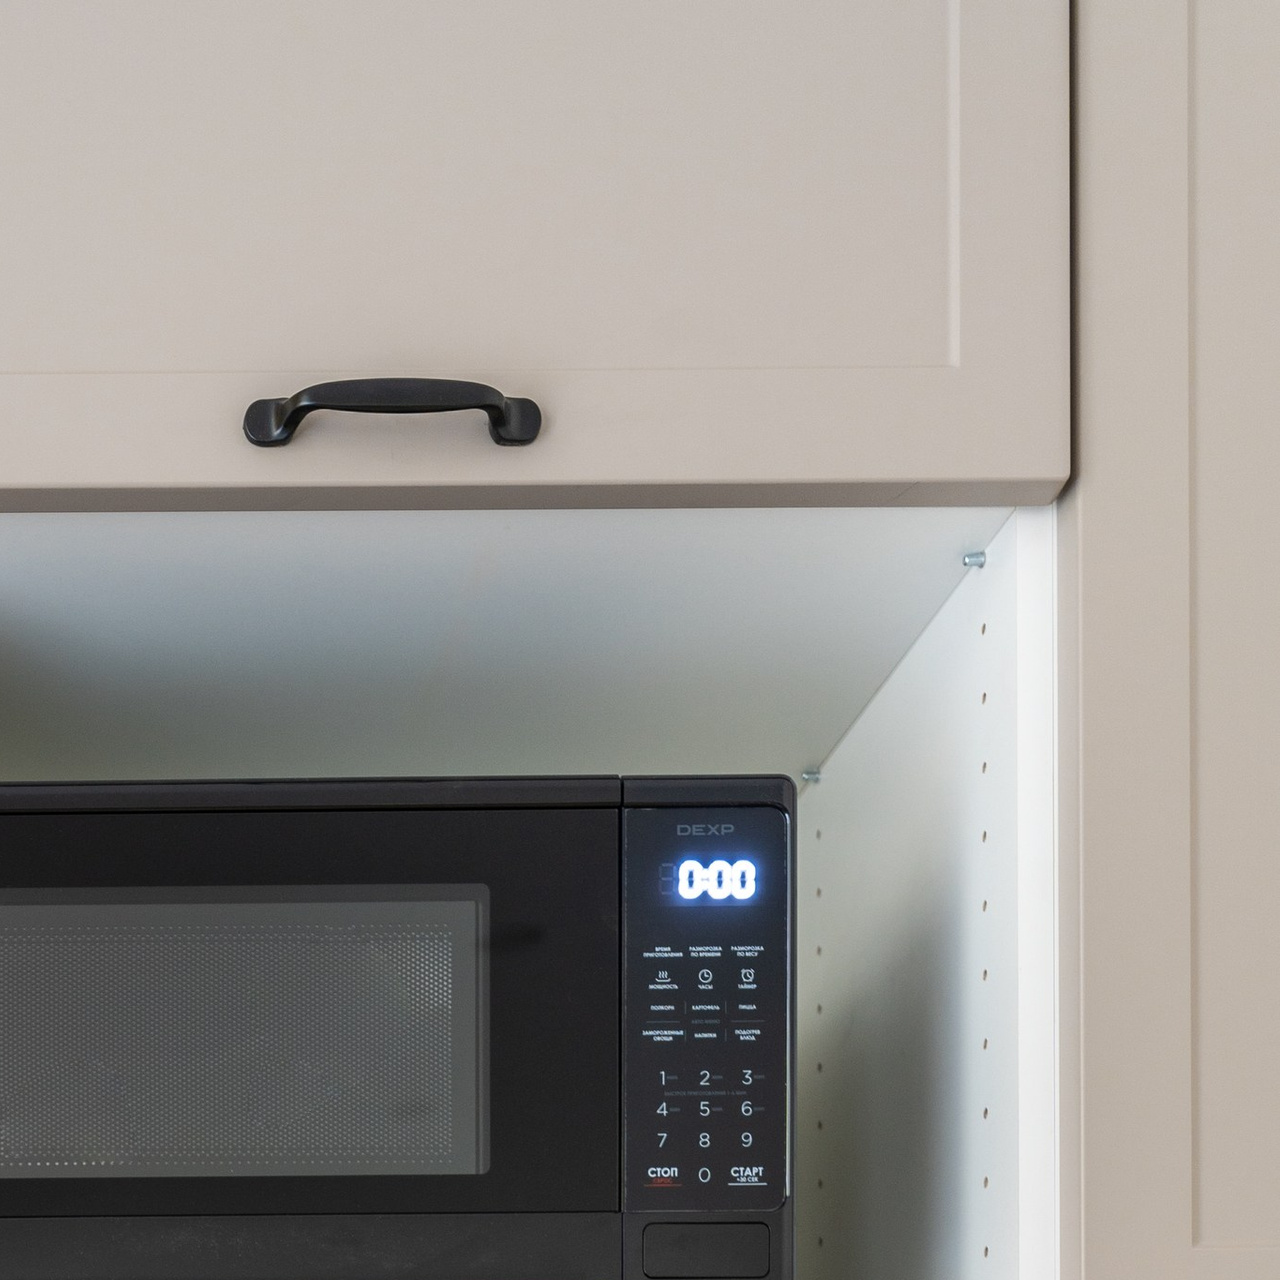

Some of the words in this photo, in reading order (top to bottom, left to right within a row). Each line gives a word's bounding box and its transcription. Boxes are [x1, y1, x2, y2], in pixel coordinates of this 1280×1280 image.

[676, 824, 734, 836] DEXP
[660, 1071, 666, 1086] 1
[699, 1070, 710, 1086] 2
[741, 1069, 753, 1085] 3
[656, 1102, 668, 1117] 4
[699, 1101, 710, 1117] 5
[741, 1101, 753, 1116] 6
[657, 1133, 668, 1148] 7
[699, 1132, 711, 1148] 8
[741, 1132, 753, 1148] 9
[647, 1167, 678, 1177] СТОП
[698, 1167, 711, 1183] 0
[730, 1166, 764, 1177] СТАРТ
